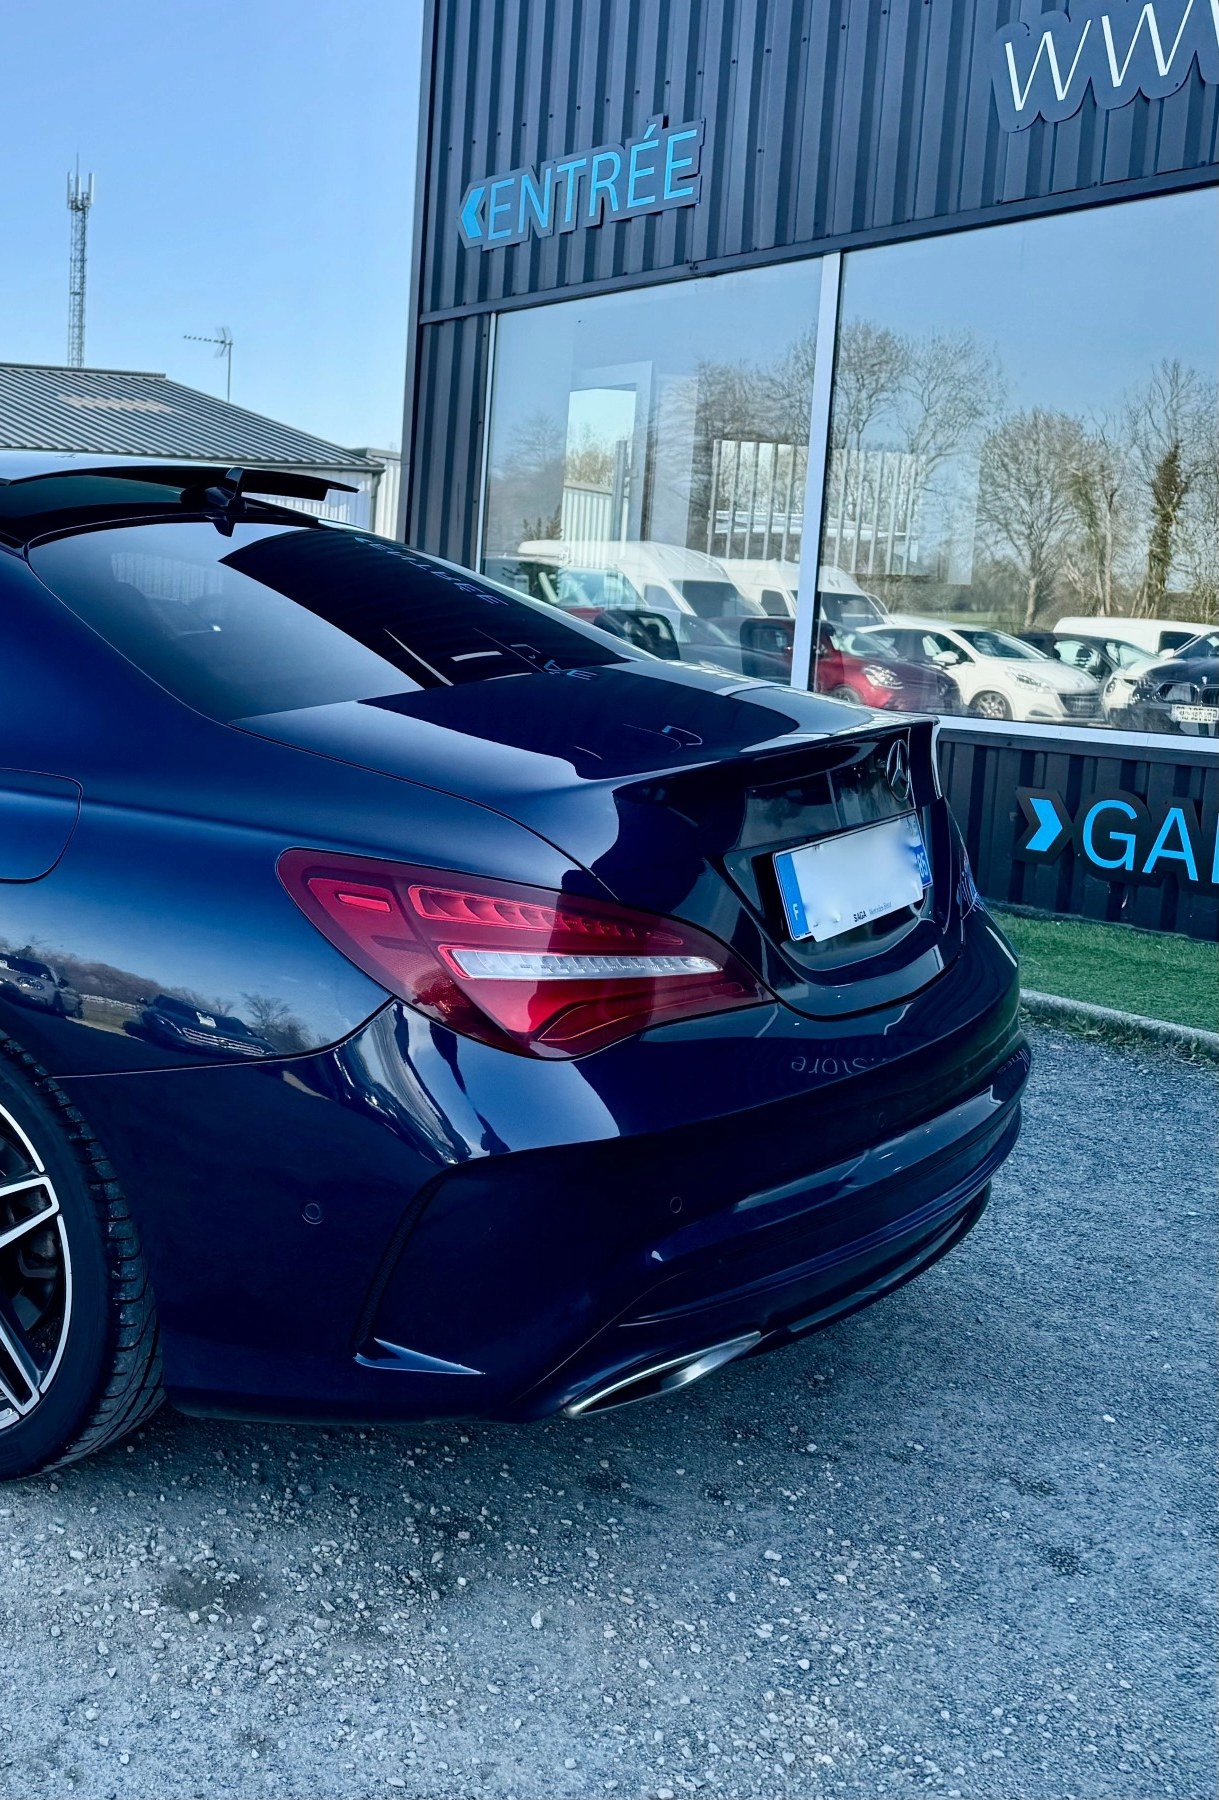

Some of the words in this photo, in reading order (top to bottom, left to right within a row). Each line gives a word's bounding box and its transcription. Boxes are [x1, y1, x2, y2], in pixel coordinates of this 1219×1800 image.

[488, 124, 698, 240] ENTRÉE
[1083, 799, 1219, 883] GA
[792, 903, 799, 920] F
